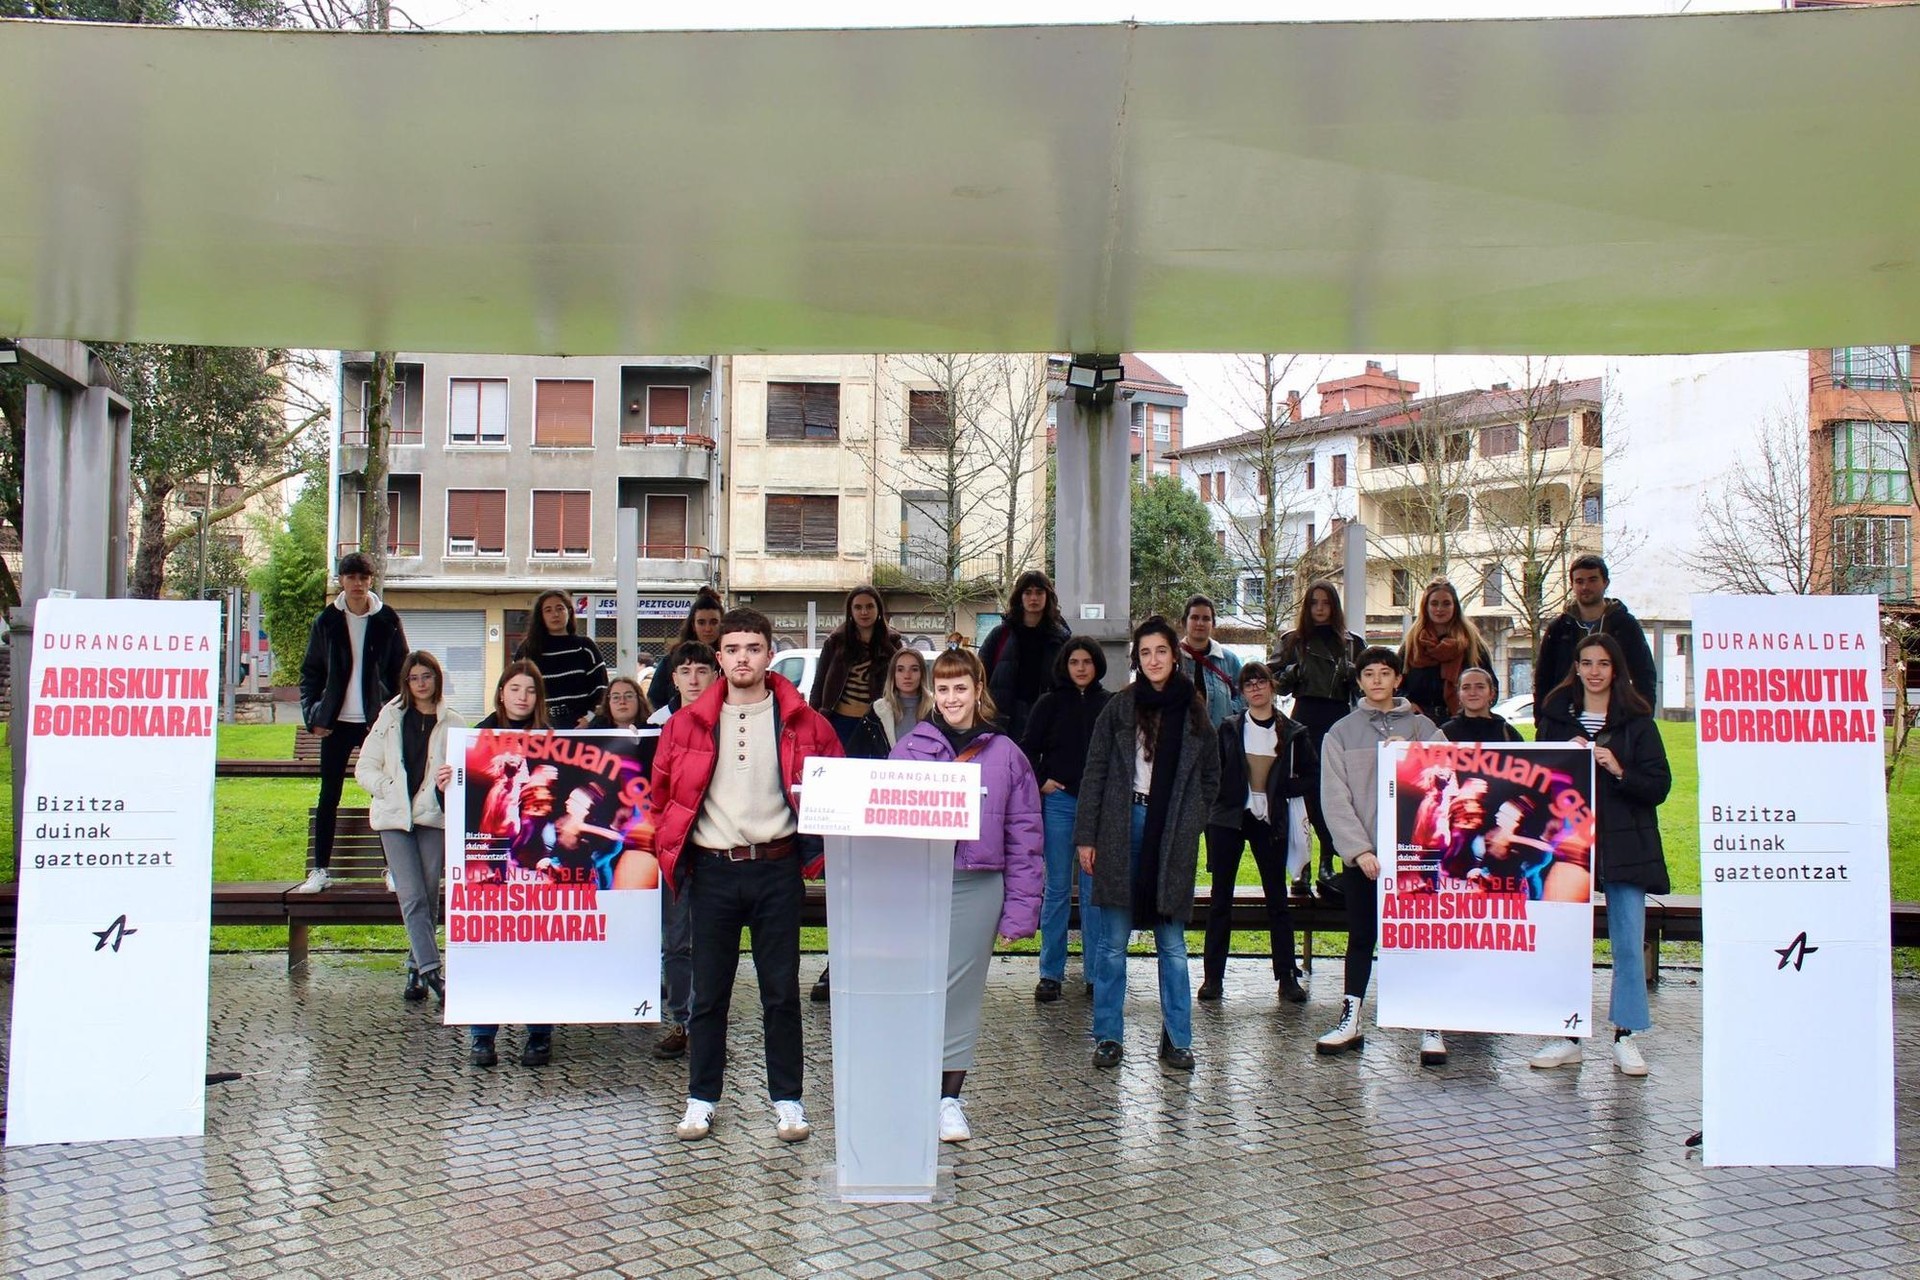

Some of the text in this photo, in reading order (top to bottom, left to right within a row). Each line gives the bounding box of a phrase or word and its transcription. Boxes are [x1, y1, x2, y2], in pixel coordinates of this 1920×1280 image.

[44, 633, 210, 652] DURANGALDEA
[1702, 632, 1866, 650] DURANGALDEA
[40, 667, 209, 699] ARRISKUTIK
[1704, 668, 1868, 702] ARRISKUTIK
[33, 705, 213, 737] BORROKARA!
[1700, 709, 1876, 743] BORROKARA!
[870, 770, 967, 783] DURANGALDEA
[37, 796, 125, 811] Bizitza
[868, 788, 967, 808] ARRISKUTIK
[864, 808, 969, 828] BORROKARA!
[1712, 805, 1797, 822] Bizitza
[36, 824, 111, 839] duinak
[1713, 835, 1785, 850] duinak
[34, 851, 173, 869] gazteontzat
[452, 866, 599, 882] DURANGALDEA
[1714, 865, 1848, 883] gazteontzat
[1384, 877, 1530, 891] DURANGALDEA
[450, 883, 598, 911] ARRISKUTIK
[1382, 892, 1528, 921] ARRISKUTIK
[450, 914, 607, 943] BORROKARA!
[1382, 922, 1536, 952] BORROKARA!
